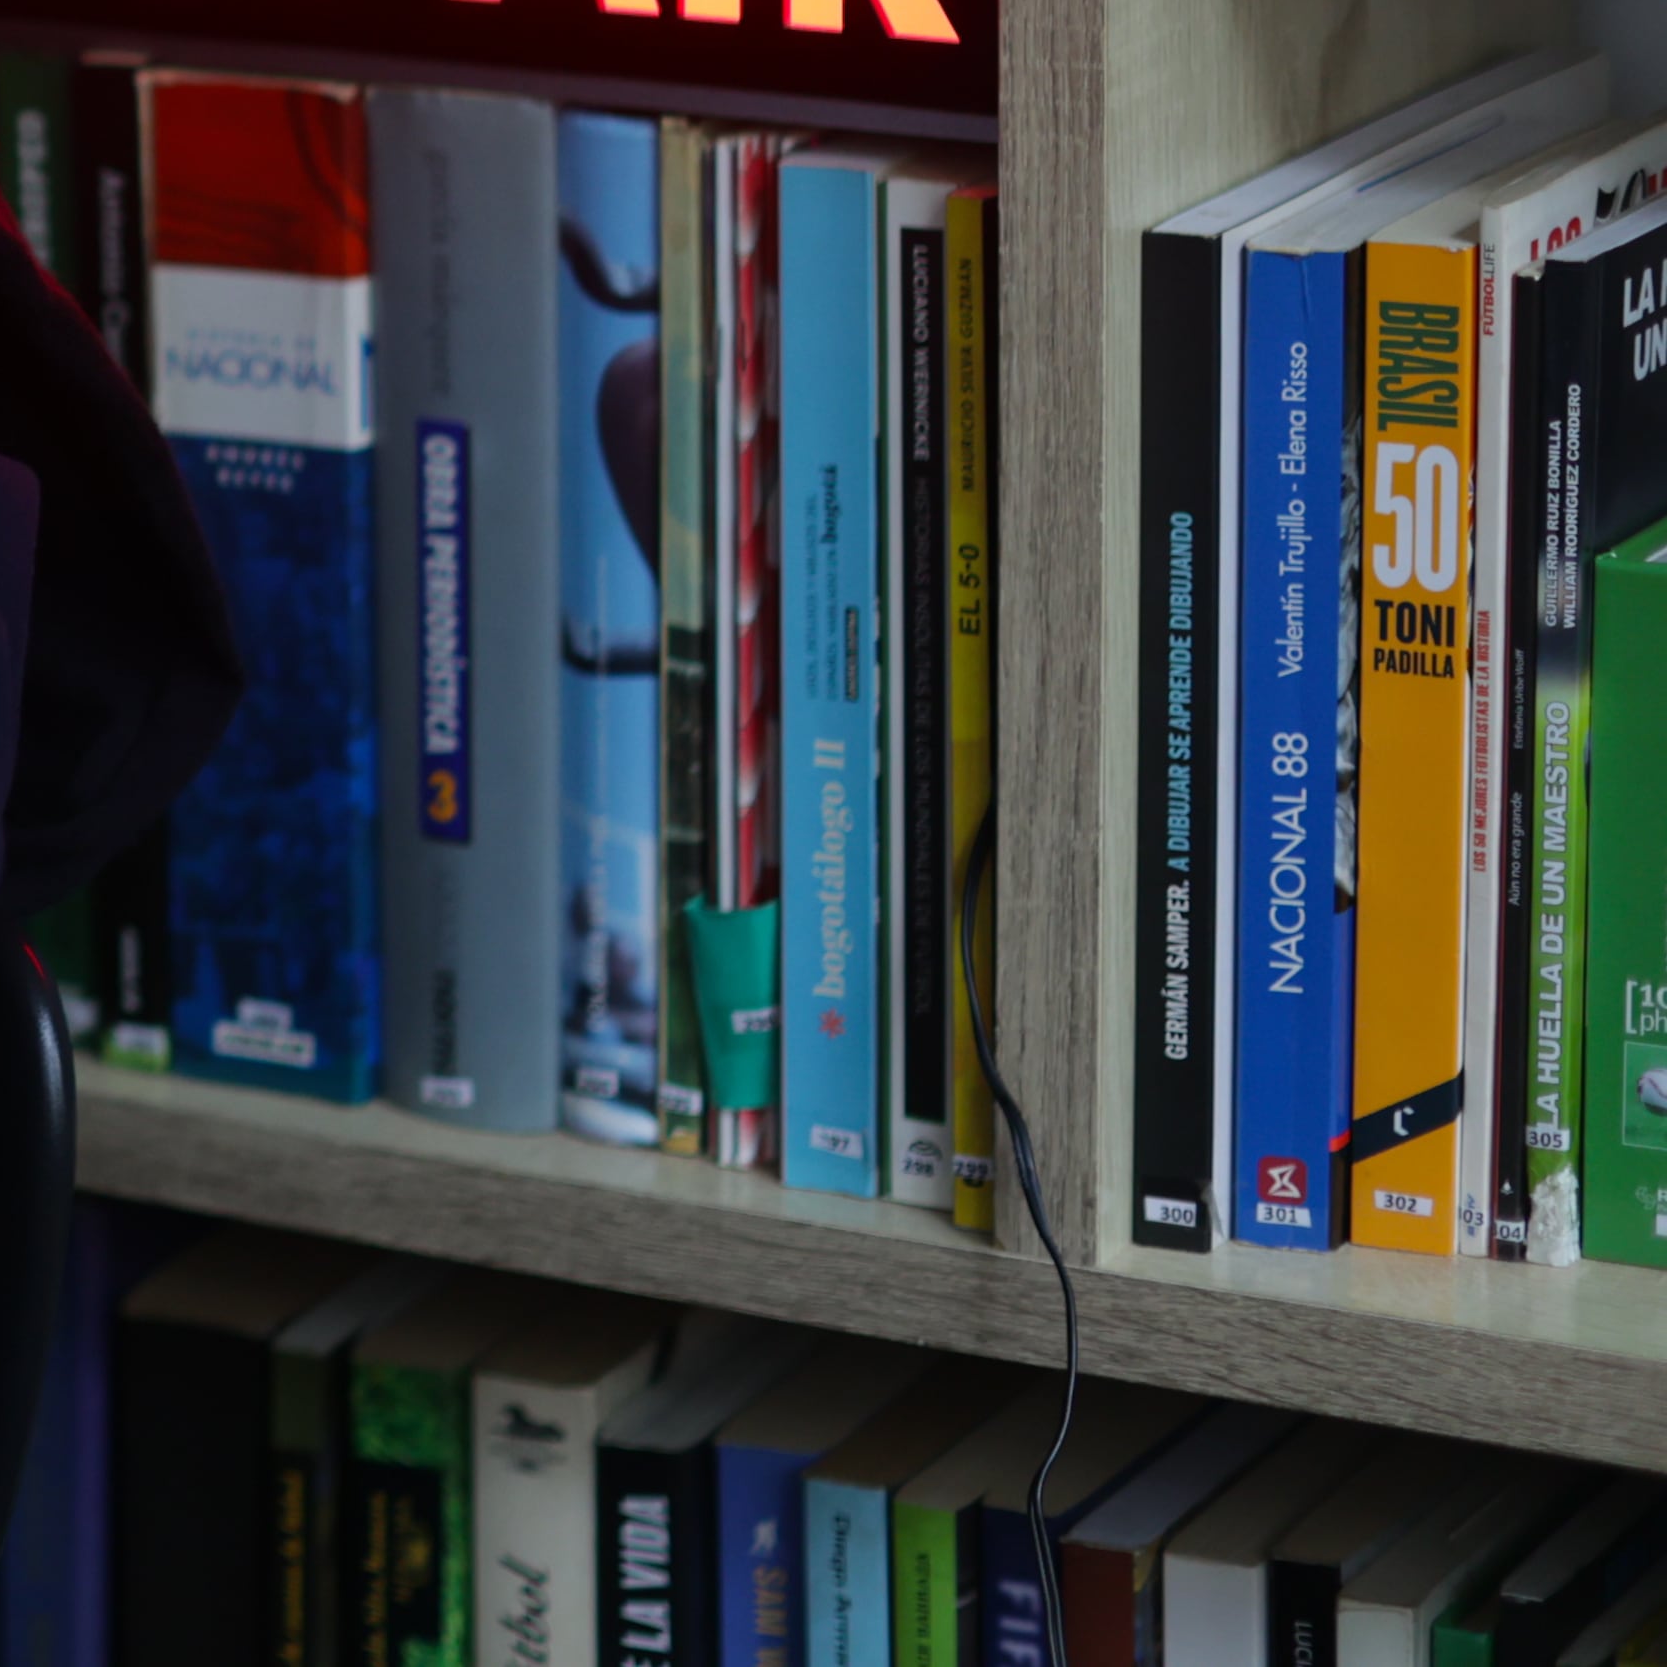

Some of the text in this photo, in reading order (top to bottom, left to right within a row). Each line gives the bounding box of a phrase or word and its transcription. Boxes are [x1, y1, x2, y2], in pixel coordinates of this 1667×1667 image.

[910, 244, 931, 462] LUCIANO WERNICKE
[1376, 300, 1460, 433] BRASIL
[1622, 266, 1656, 329] LA
[955, 257, 976, 491] MAURICIO SILVA GUZMÁN
[424, 433, 459, 527] OBRA
[1274, 340, 1315, 678] Valentín Trujillo Elena Risso
[1372, 440, 1460, 594] 50
[1544, 419, 1563, 628] GUILLERMO RUIZ BONILLA
[1563, 383, 1582, 629] WILLIAM RODRÍGUEZ CORDERO
[424, 531, 468, 755] PERIODÍSTICA
[957, 543, 982, 635] EL 5-0
[1373, 599, 1456, 648] TONI
[1373, 648, 1455, 680] PADILLA
[426, 768, 459, 824] 3
[1160, 510, 1194, 1062] GERMÁN SAMPER. A DIBUJAR SE APRENDE DIBUJANDO
[1473, 610, 1491, 872] LOS MEJORES FUTBOLISTAS HISTORIA
[811, 737, 854, 999] bogotálogo II
[1268, 731, 1310, 995] NACIONAL 88
[1508, 790, 1526, 907] Aún era grande
[1536, 701, 1570, 1130] LA HUELLA DE UN MAESTRO
[1384, 1194, 1418, 1214] 302
[1527, 1130, 1565, 1149] 305
[1160, 1206, 1194, 1225] 300
[1262, 1206, 1299, 1225] 301
[1457, 1208, 1485, 1227] 03
[616, 1493, 671, 1654] LA VIDA
